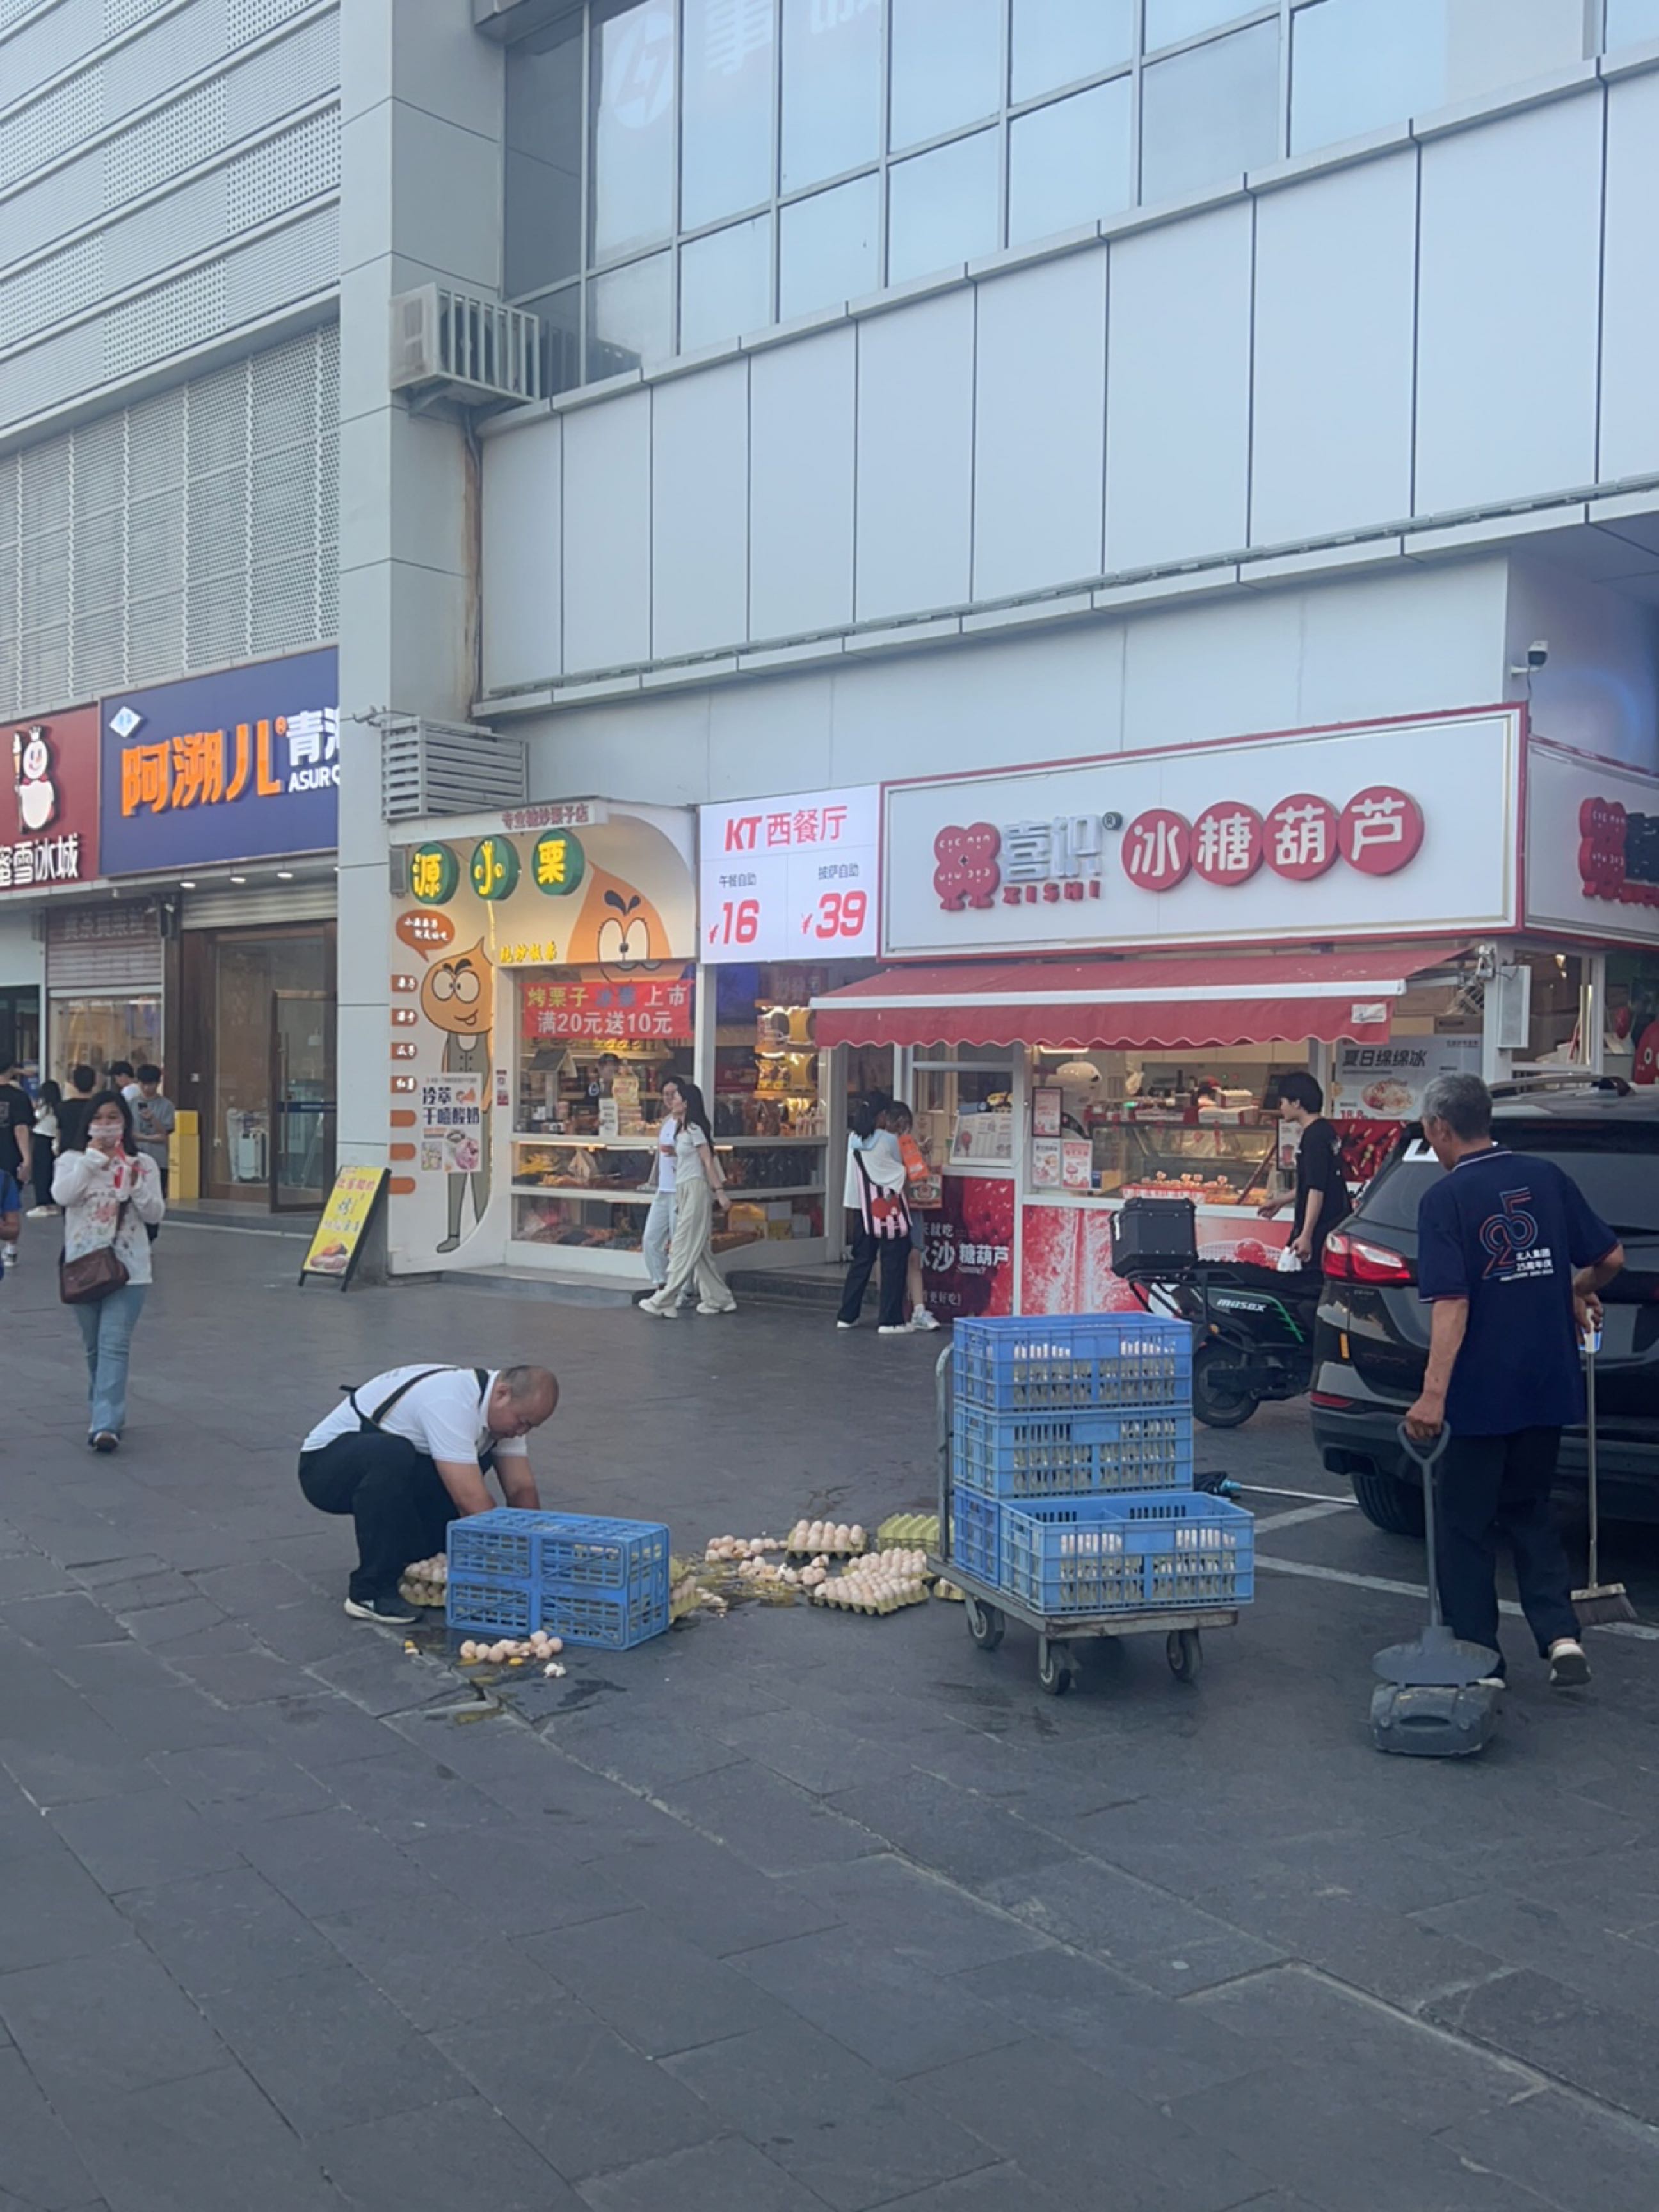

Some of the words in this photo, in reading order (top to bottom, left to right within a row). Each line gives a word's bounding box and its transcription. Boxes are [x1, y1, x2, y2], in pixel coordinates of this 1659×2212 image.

[725, 806, 847, 852] KT西餐厅
[1129, 797, 1406, 876] 冰糖葫芦
[413, 840, 566, 897] 源小栗
[538, 1011, 673, 1035] 满20元送10元
[1342, 1048, 1428, 1067] 夏日绵绵冰
